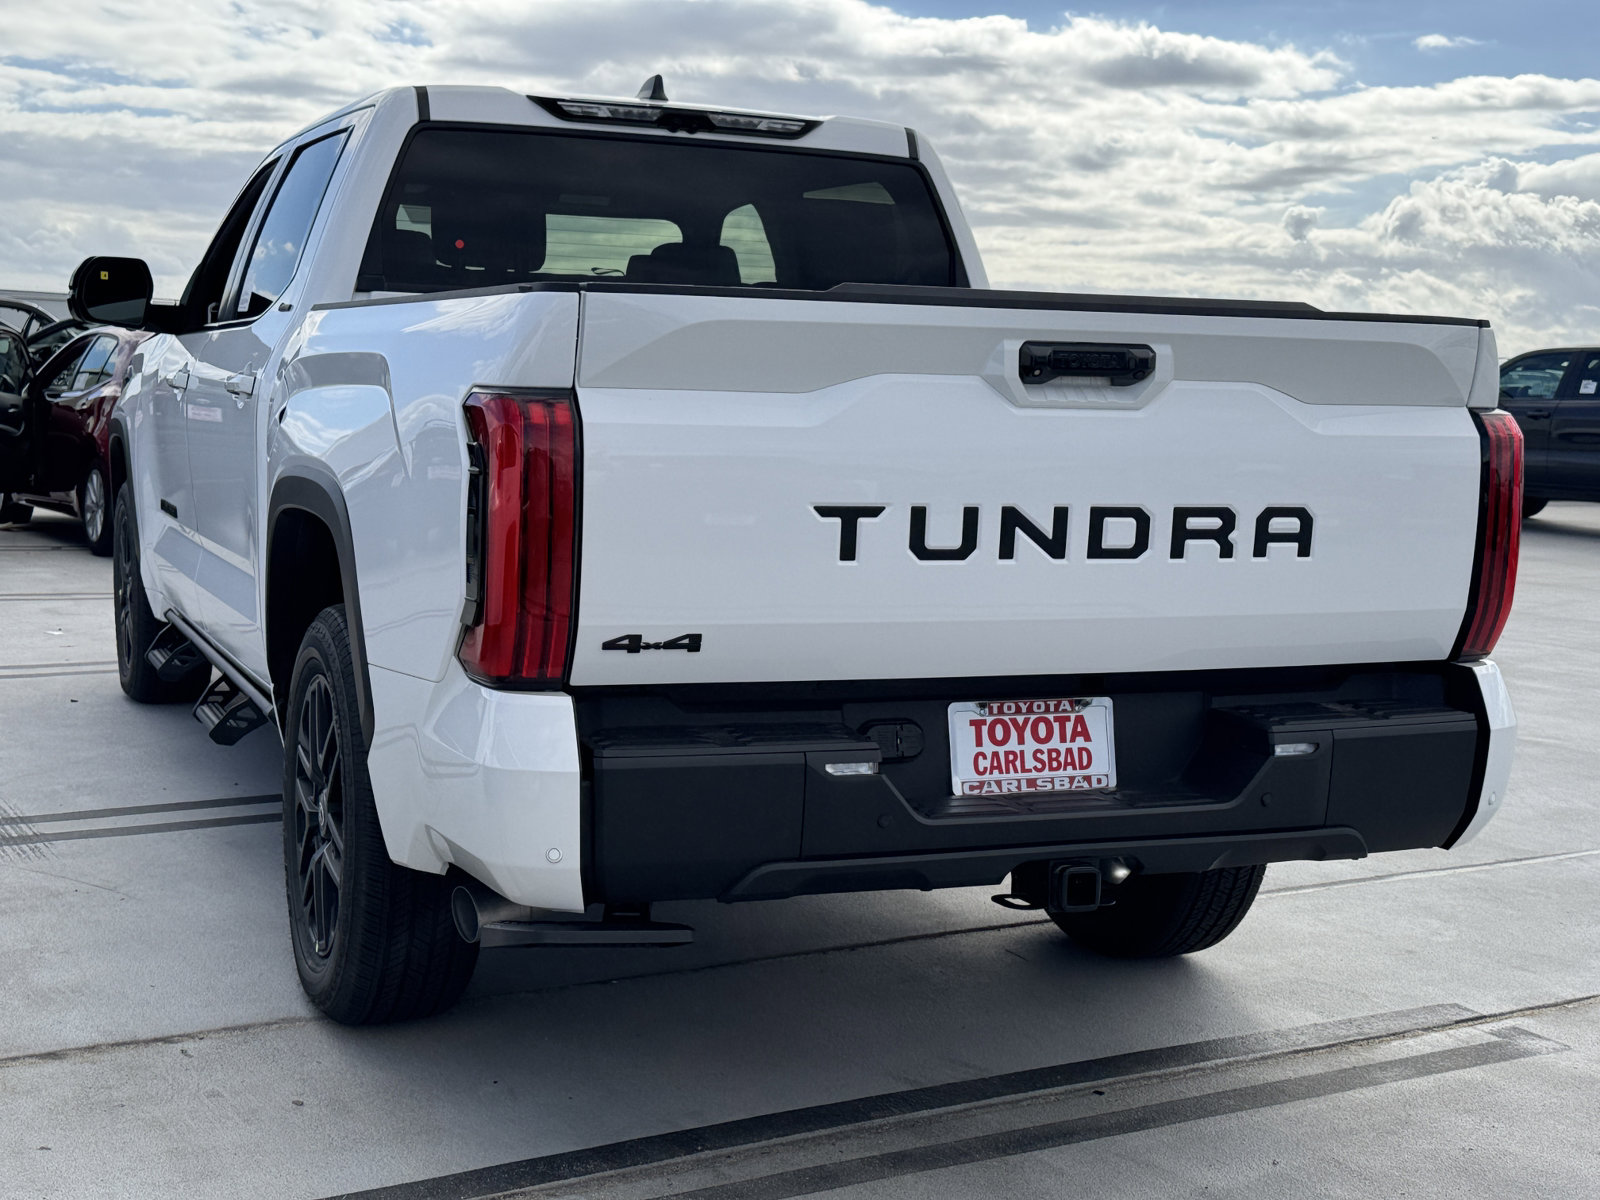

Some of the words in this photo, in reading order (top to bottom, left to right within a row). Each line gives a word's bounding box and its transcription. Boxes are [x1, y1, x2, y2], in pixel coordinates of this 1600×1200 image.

[812, 505, 1314, 562] TUNDRA
[602, 633, 702, 654] 4x4
[989, 700, 1072, 715] TOYOTA
[969, 714, 1092, 748] TOYOTA
[973, 746, 1093, 776] CARLSBAD
[962, 775, 1109, 795] CARLSBAD
